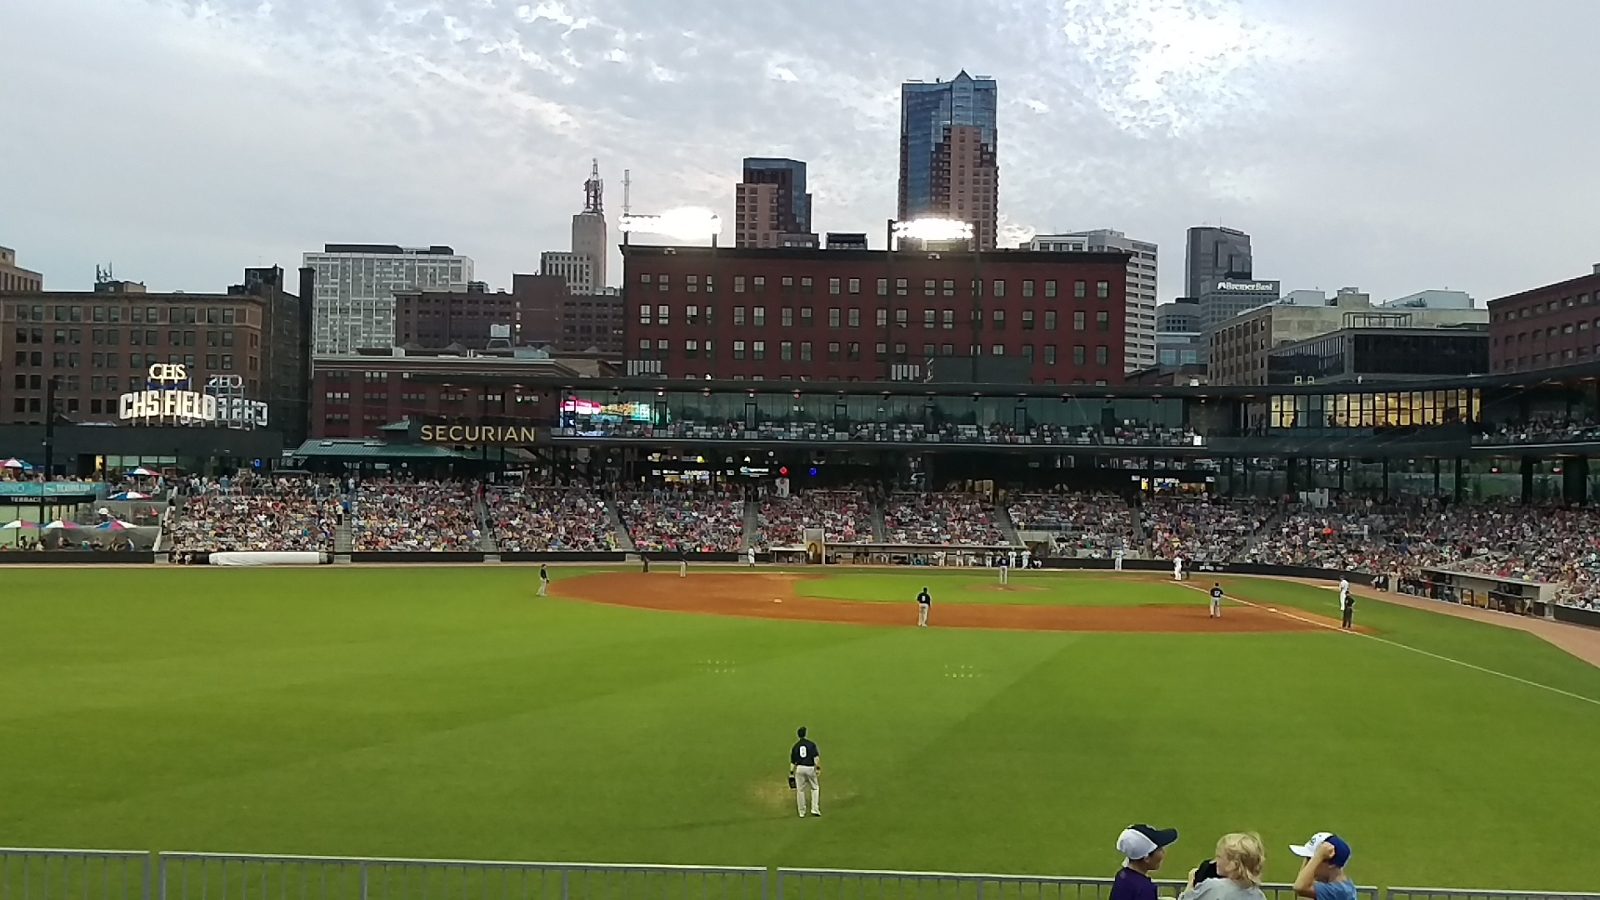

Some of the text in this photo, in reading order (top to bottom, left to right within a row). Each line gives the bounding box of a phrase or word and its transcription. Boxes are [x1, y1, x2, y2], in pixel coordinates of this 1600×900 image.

[149, 363, 187, 379] CHS
[119, 390, 160, 419] CHS
[164, 390, 216, 420] FIELD
[420, 425, 536, 442] SECURIAN
[799, 745, 807, 758] 8
